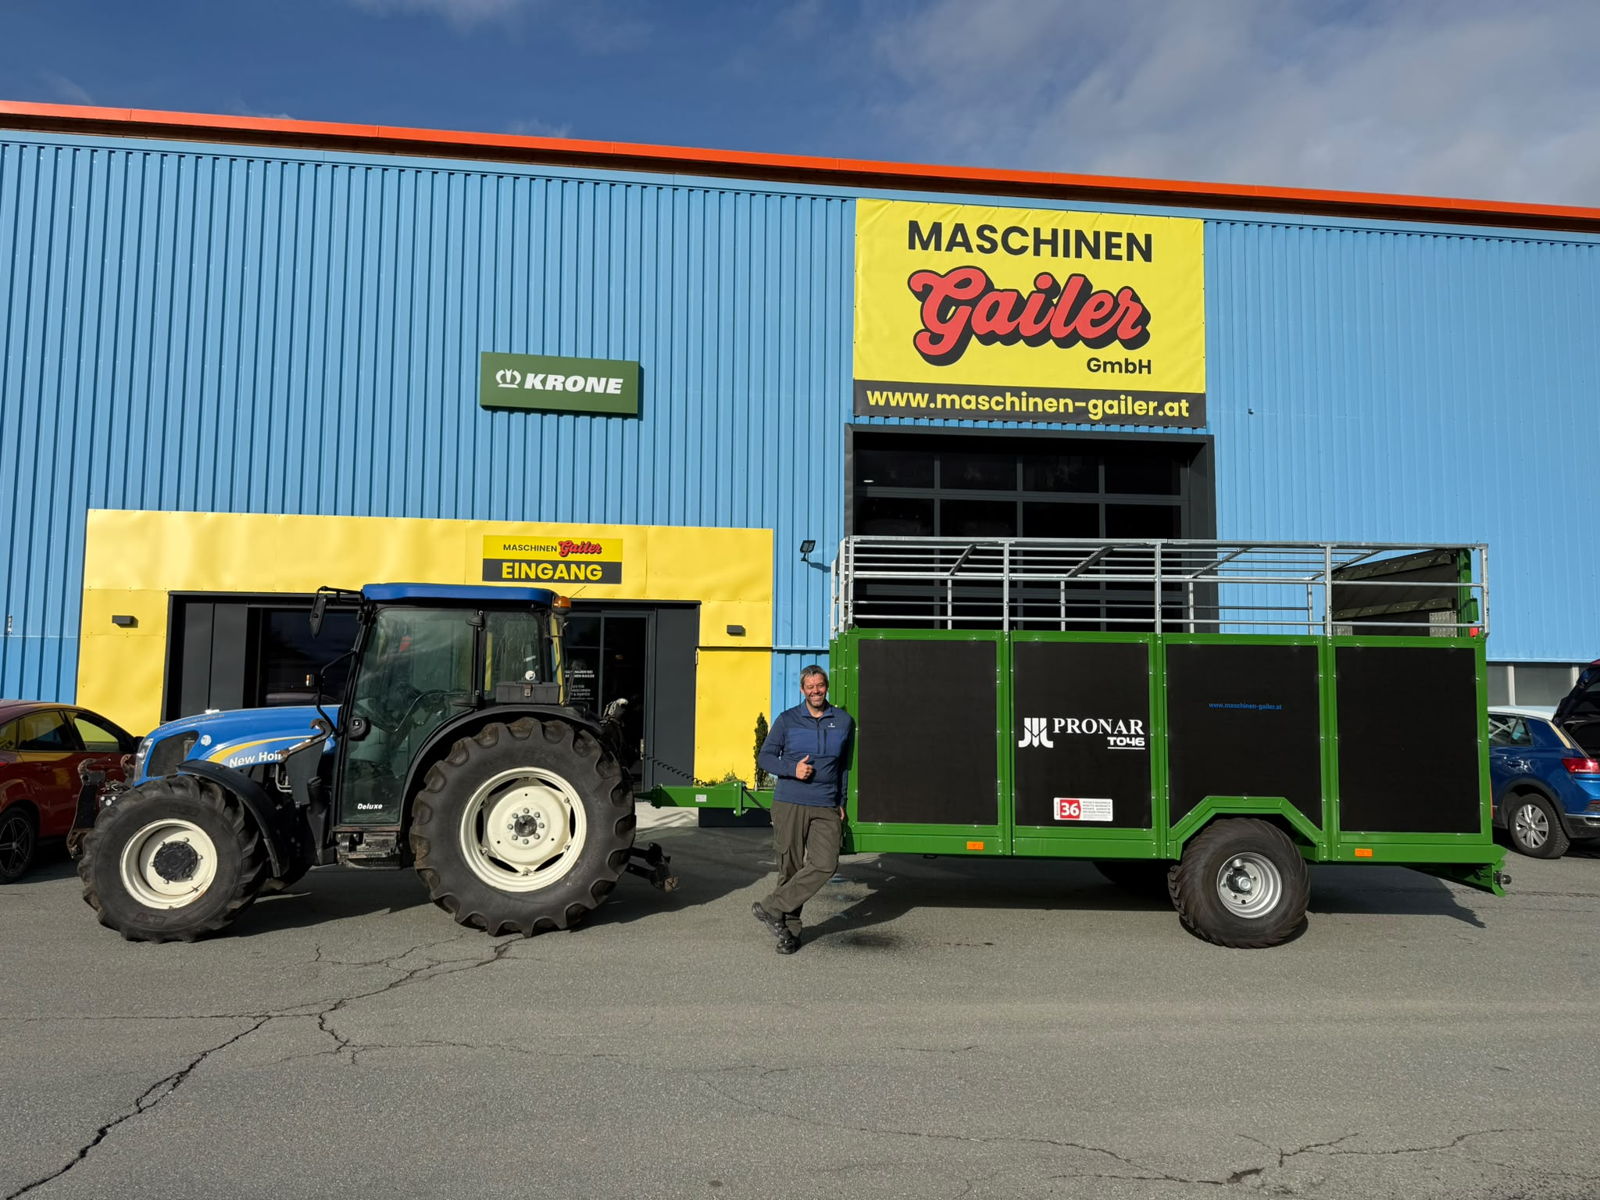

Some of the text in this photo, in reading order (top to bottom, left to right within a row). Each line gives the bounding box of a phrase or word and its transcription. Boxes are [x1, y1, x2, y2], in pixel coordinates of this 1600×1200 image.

[908, 220, 1152, 262] MASCHINEN
[907, 265, 1151, 366] Gailer
[1086, 357, 1152, 375] GmbH
[524, 373, 623, 394] KRONE
[866, 389, 1189, 420] www.maschinen-gailer.at
[503, 540, 602, 557] MASCHINEN Gailer
[502, 562, 602, 580] EINGANG
[1053, 718, 1145, 735] PRONAR
[229, 755, 255, 768] New
[1061, 802, 1080, 816] 36
